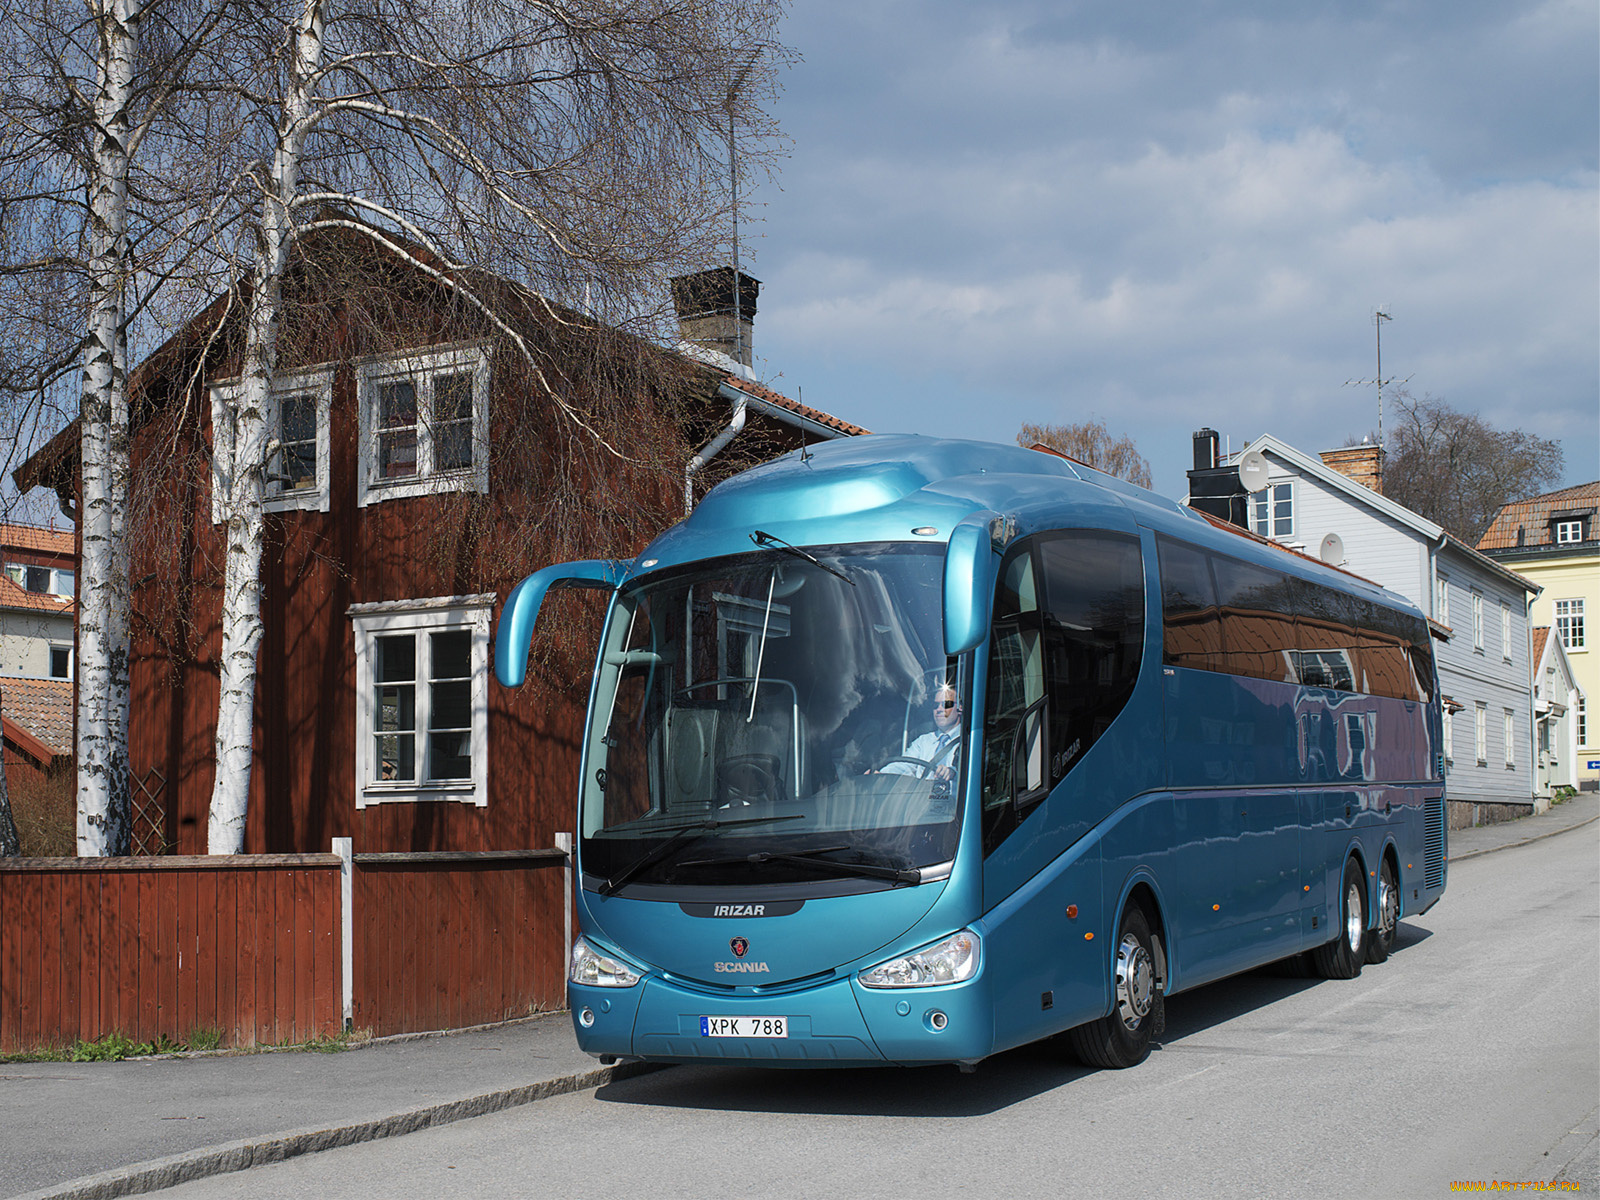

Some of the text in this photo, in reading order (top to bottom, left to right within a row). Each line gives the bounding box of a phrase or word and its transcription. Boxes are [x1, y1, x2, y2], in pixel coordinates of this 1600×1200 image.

[713, 905, 765, 916] IRIZAR
[713, 961, 770, 973] SCANIA
[710, 1019, 740, 1035] XPK
[752, 1019, 783, 1035] 788
